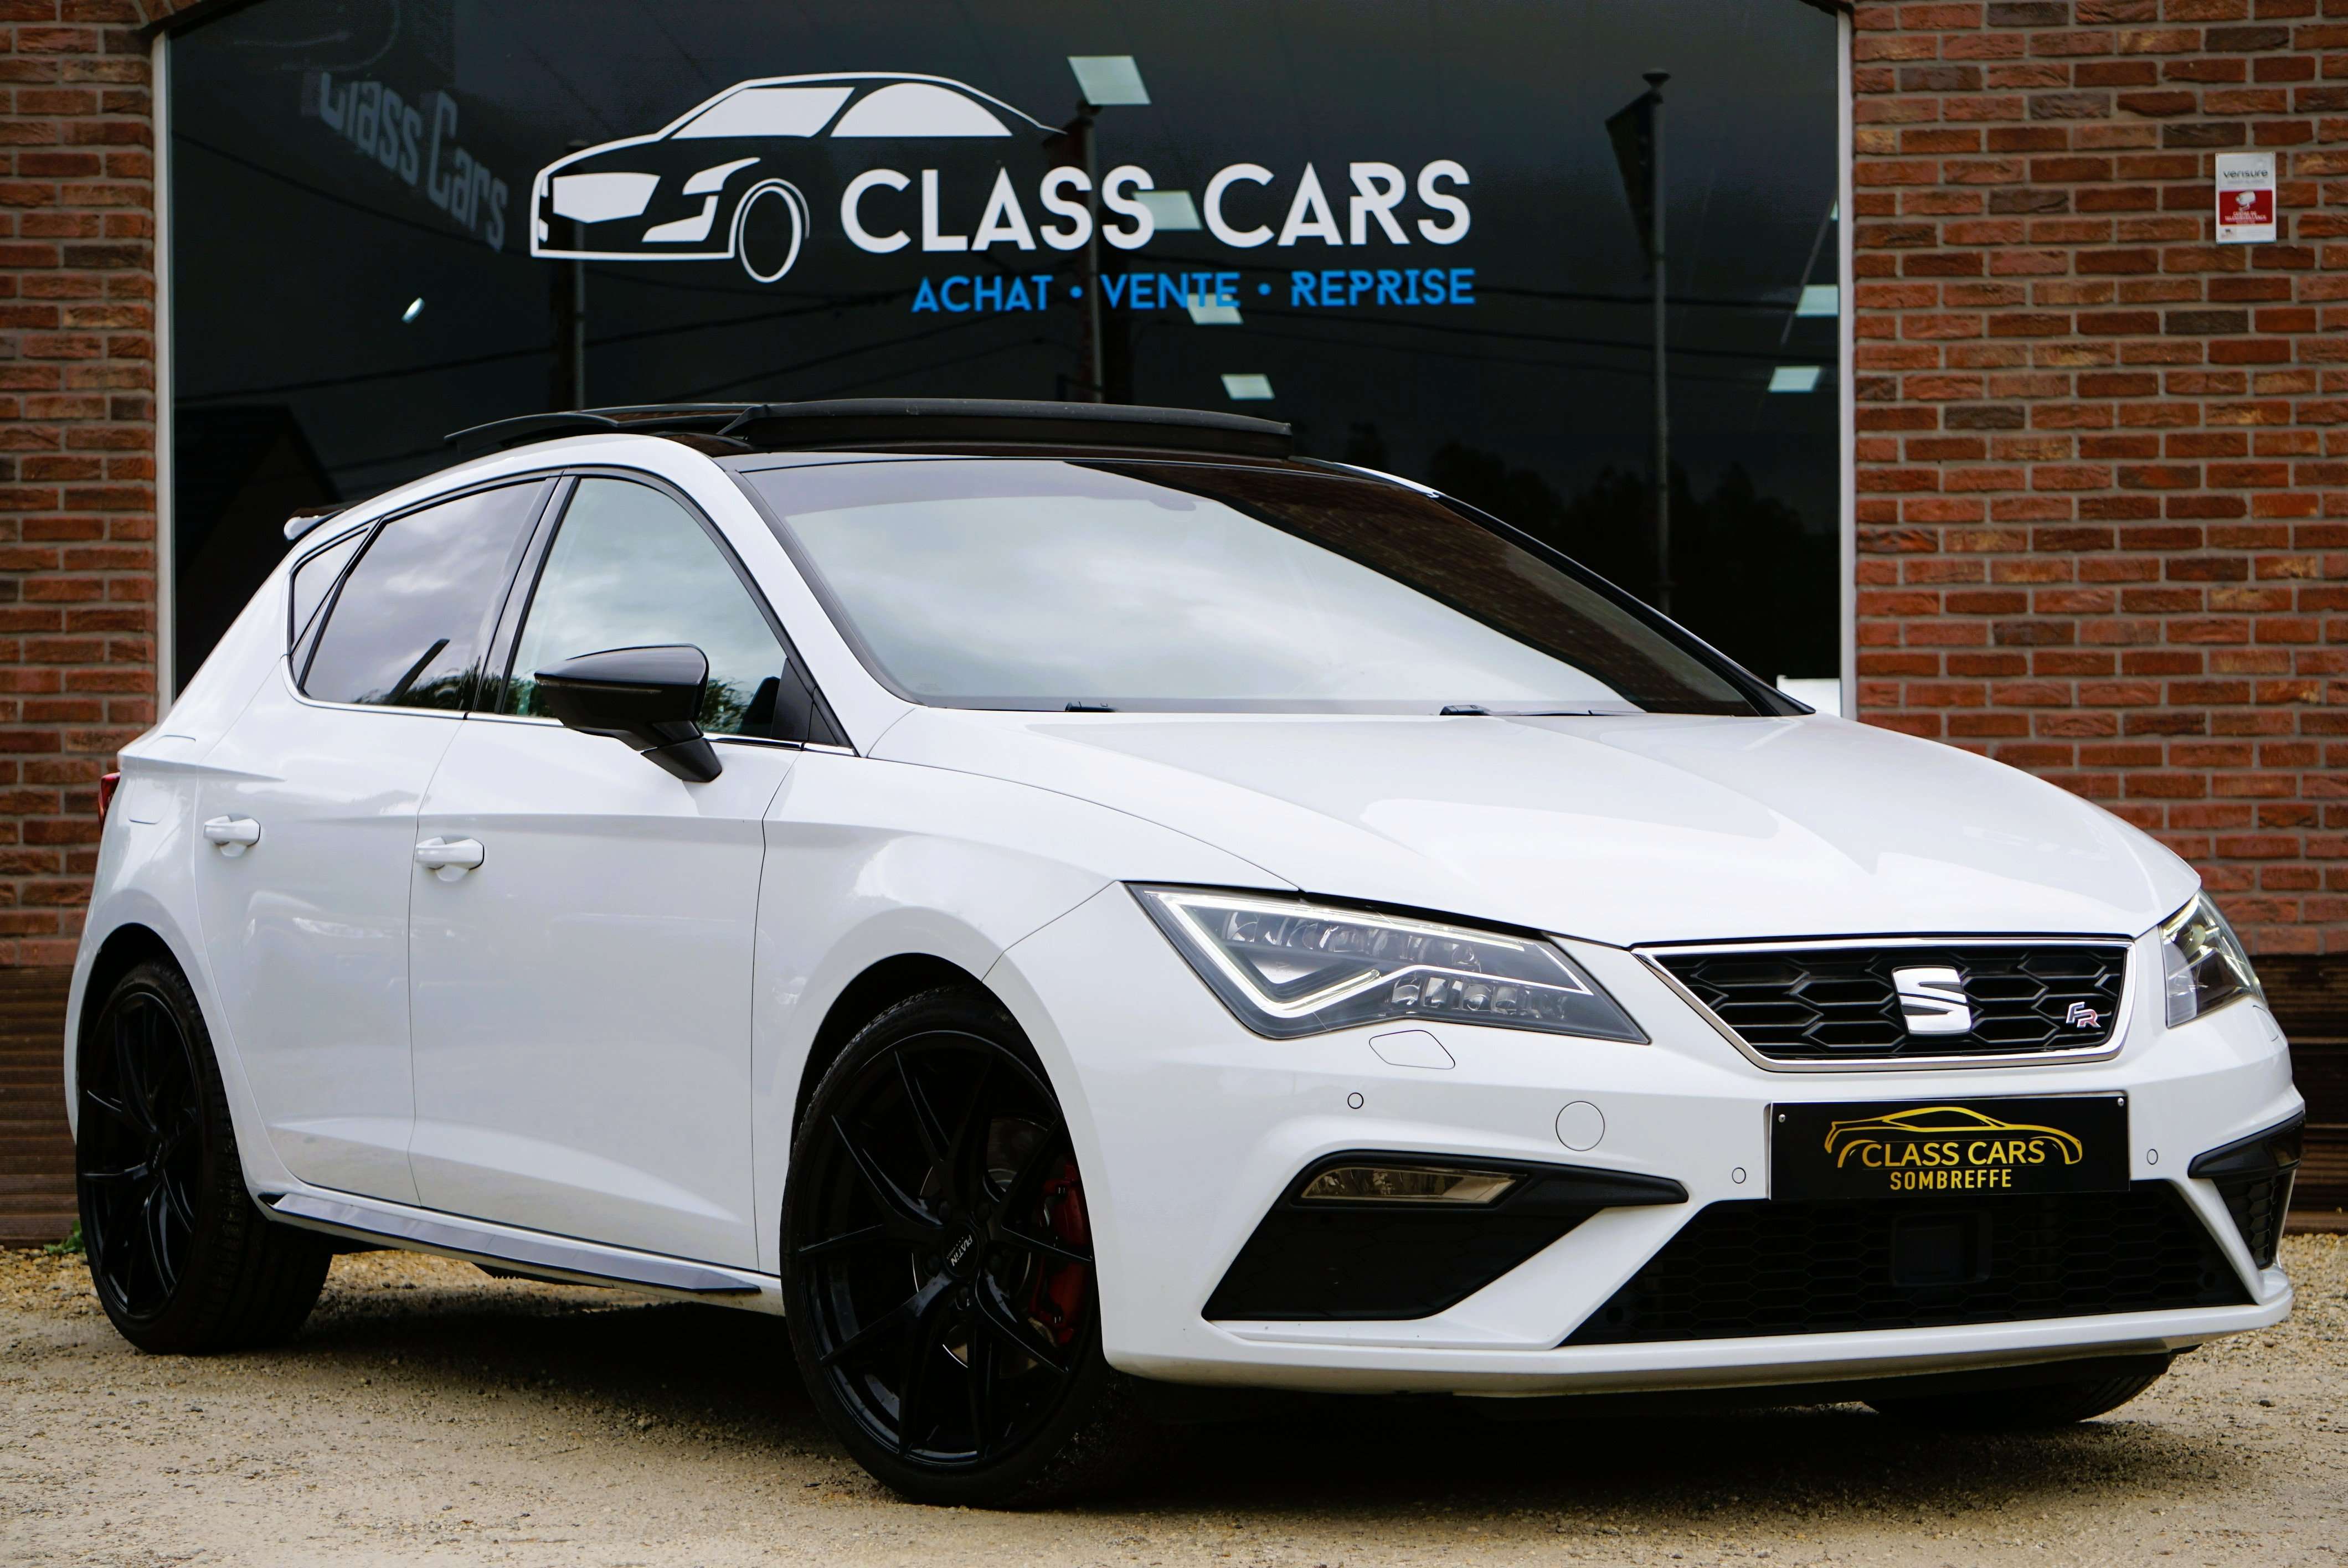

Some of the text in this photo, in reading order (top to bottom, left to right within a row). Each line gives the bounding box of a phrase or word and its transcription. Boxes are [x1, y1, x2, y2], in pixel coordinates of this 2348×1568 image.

[428, 91, 508, 252] Cars
[2223, 169, 2268, 178] verisure
[841, 160, 1470, 252] CLASS CARS
[912, 267, 1476, 313] ACHAT VENTE REPRISE
[2066, 1001, 2101, 1028] FR
[1862, 1140, 2046, 1168] CLASS CARS
[1889, 1168, 2012, 1190] SOMBREFFE
